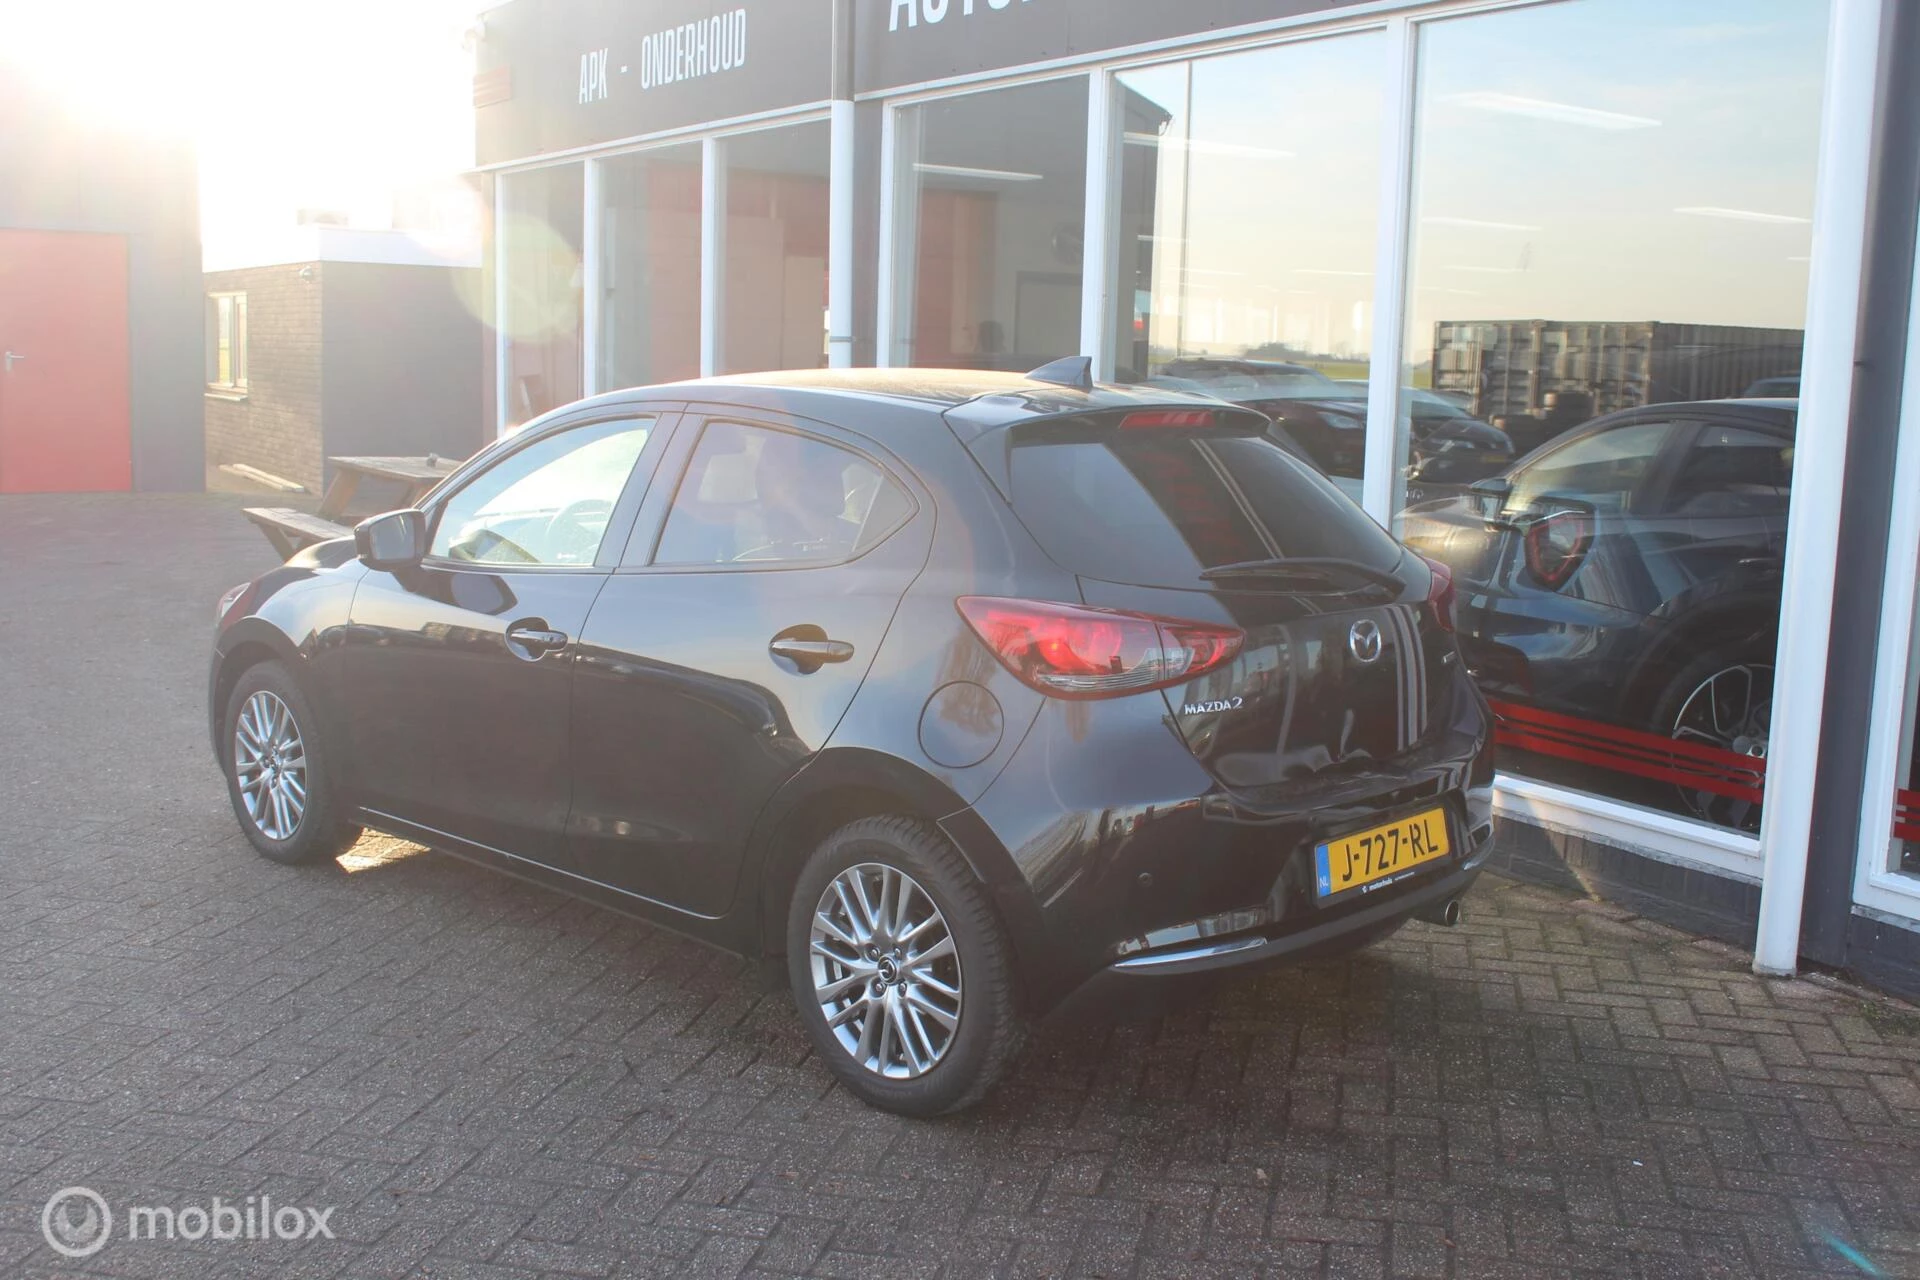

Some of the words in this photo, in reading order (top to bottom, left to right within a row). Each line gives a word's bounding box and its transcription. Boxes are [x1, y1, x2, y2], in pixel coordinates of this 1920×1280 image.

[579, 48, 608, 104] APK
[641, 9, 746, 89] ONDERHOUD
[1319, 876, 1329, 888] NL
[1342, 819, 1439, 882] J-727-RL
